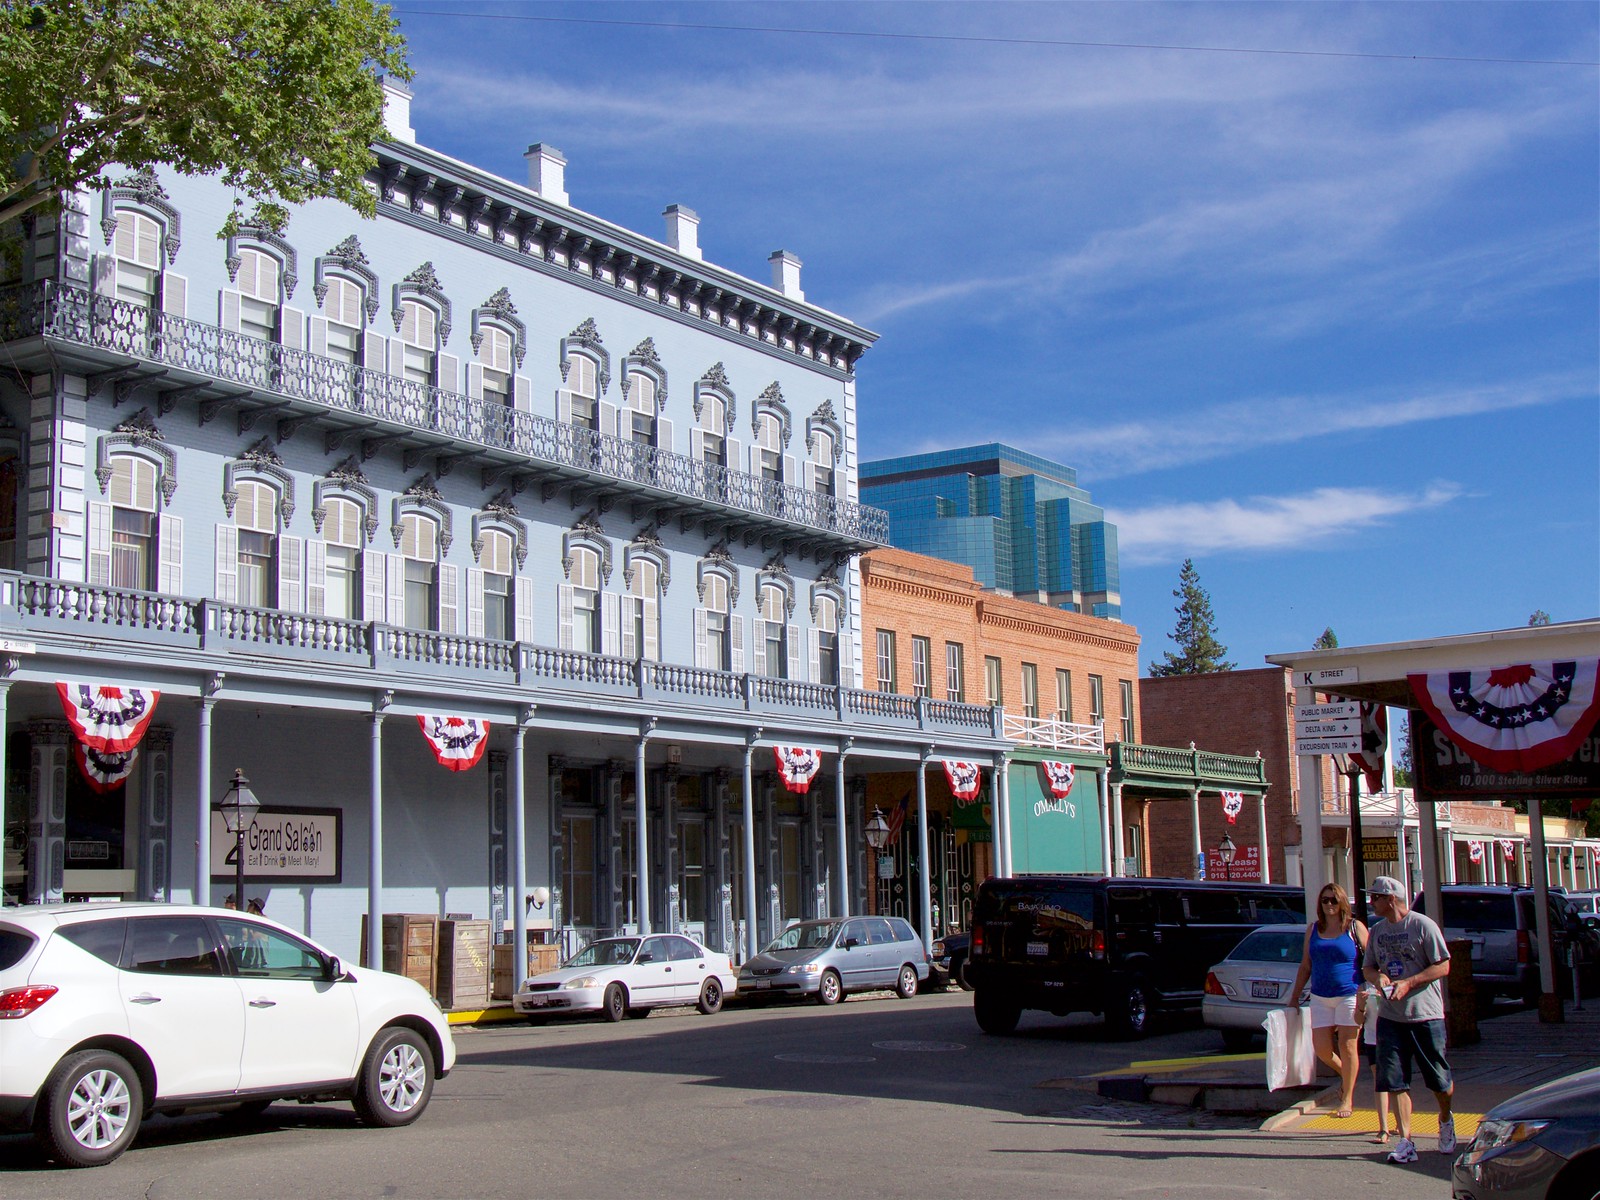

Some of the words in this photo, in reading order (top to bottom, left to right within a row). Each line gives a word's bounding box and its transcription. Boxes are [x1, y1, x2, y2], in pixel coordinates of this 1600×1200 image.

[4, 641, 9, 649] 2
[1304, 672, 1313, 684] K
[1321, 670, 1344, 678] STREET
[1301, 708, 1319, 716] PUBLIC
[1321, 707, 1344, 715] MARKET
[1300, 742, 1330, 751] EXCURSION
[1459, 774, 1495, 786] 10,000
[1498, 775, 1533, 786] Sterling
[1535, 775, 1560, 785] Silver
[1563, 774, 1588, 784] Rings
[249, 821, 281, 850] Grand
[248, 855, 258, 866] Eat
[264, 855, 278, 866] Drink
[288, 855, 302, 866] Meet
